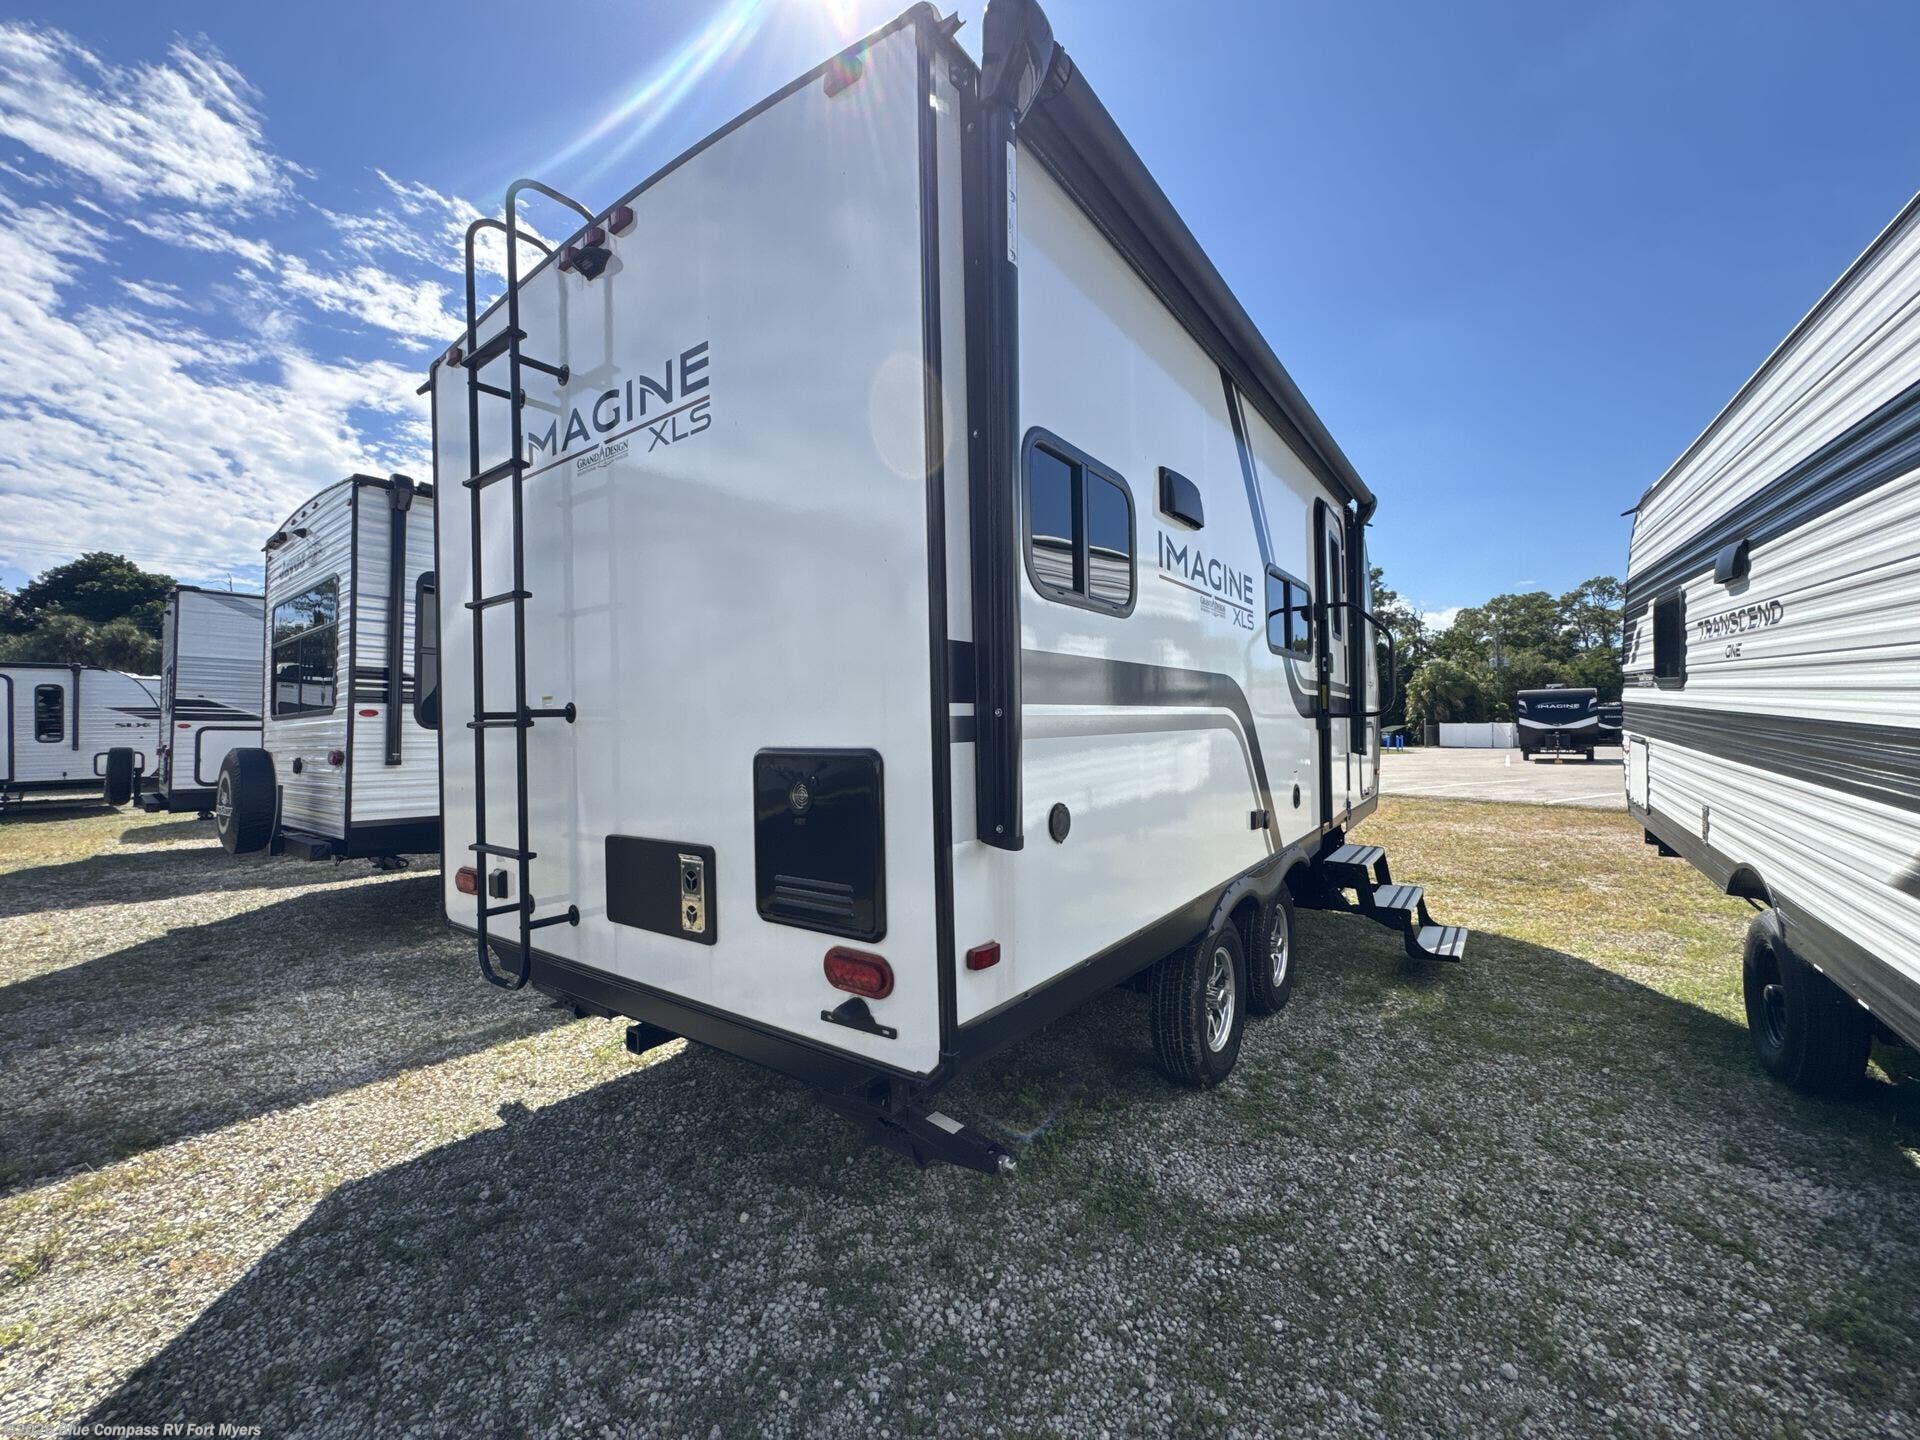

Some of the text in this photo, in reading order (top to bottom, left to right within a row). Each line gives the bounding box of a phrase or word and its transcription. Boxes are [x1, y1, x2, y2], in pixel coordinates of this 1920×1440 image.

[521, 340, 710, 466] MAGINE
[647, 402, 712, 453] XLS
[1158, 531, 1254, 606] IMAGINE
[1232, 608, 1254, 631] XLS
[1697, 600, 1784, 641] TRANSCEND
[1725, 643, 1743, 659] ONE
